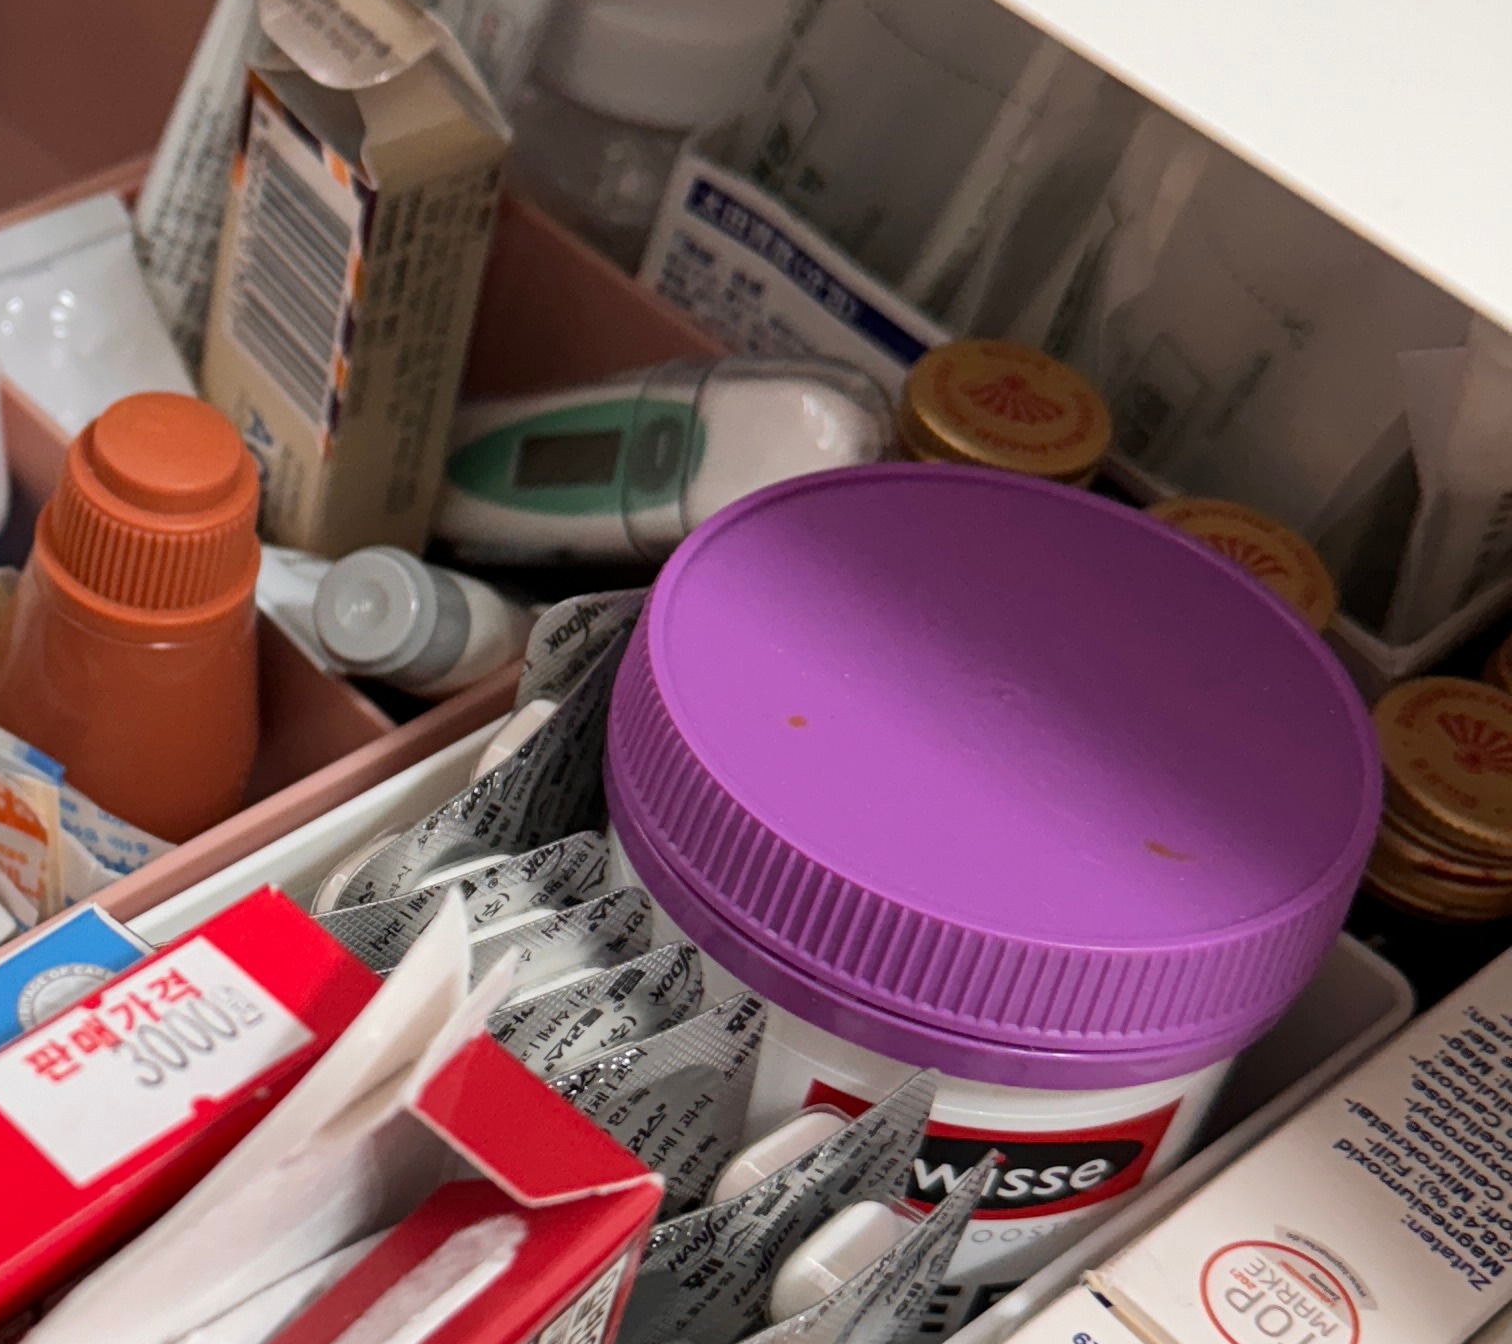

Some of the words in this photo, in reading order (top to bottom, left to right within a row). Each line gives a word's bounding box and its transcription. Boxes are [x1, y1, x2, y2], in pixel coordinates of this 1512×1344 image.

[472, 890, 510, 924] (주)
[22, 962, 203, 1087] 판매가격
[679, 1091, 714, 1129] 과식
[1411, 1056, 1502, 1128] Carboxy-
[912, 1157, 1109, 1199] wisse
[1346, 1099, 1475, 1202] Mikrokristal-
[1406, 1110, 1504, 1201] Cellulose,
[666, 1191, 754, 1272] HANDOK
[1335, 1140, 1505, 1275] Magnesiumoxid
[1402, 1215, 1491, 1290] Zutaten:
[1245, 1259, 1337, 1336] MARKE
